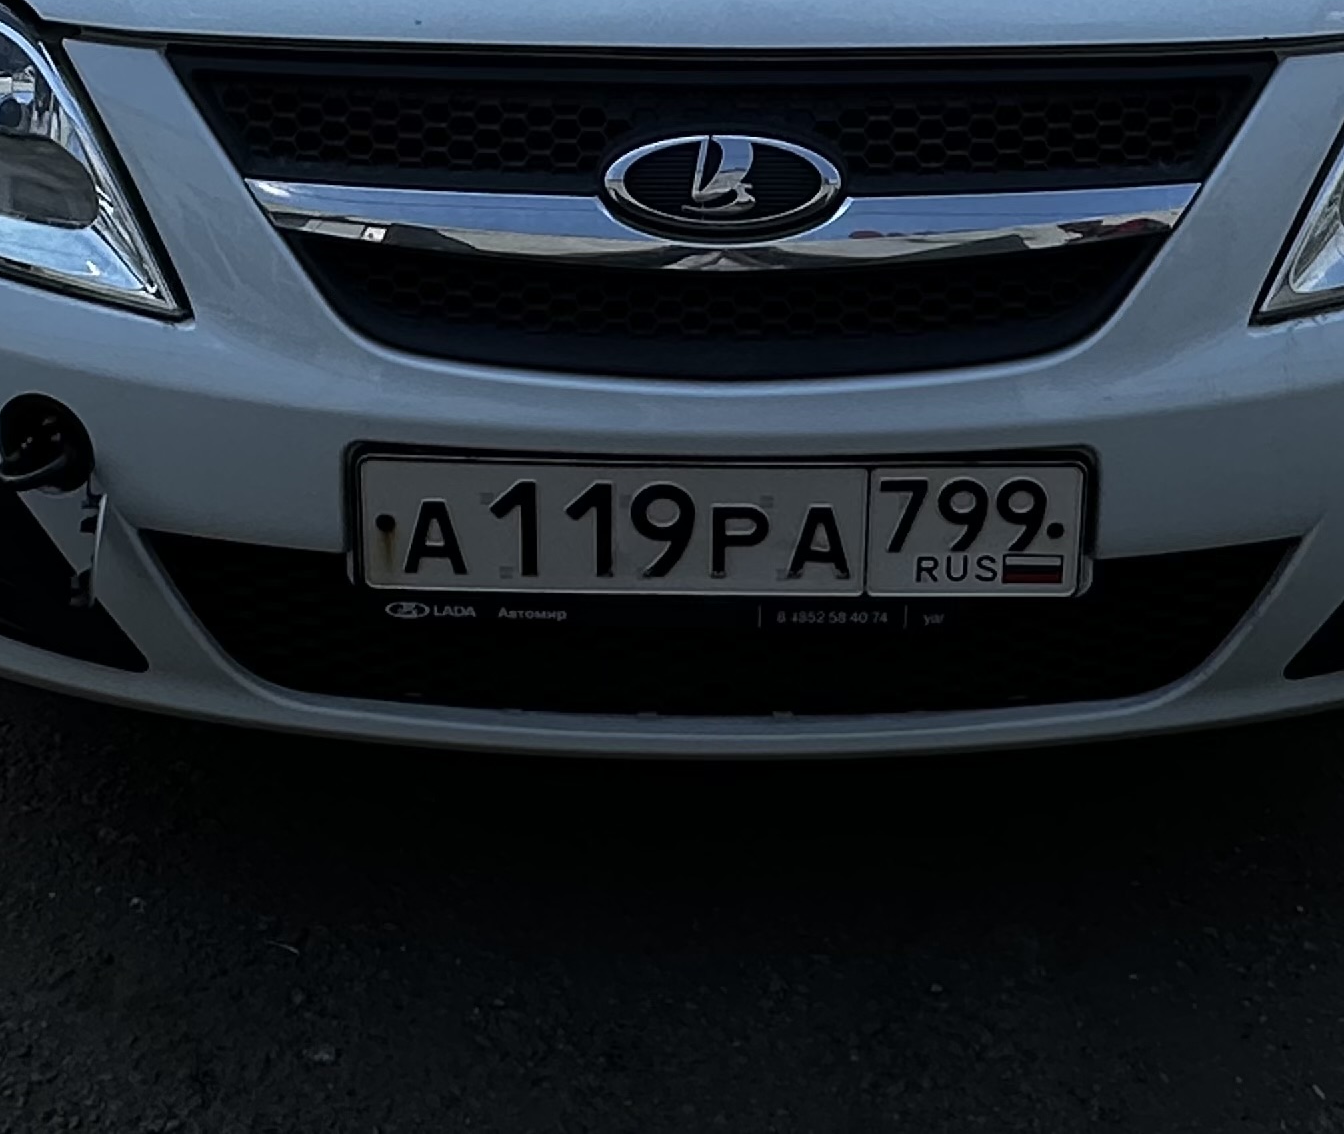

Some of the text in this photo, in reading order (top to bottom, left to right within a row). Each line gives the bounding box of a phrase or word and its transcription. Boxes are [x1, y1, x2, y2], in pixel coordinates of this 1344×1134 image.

[879, 478, 1049, 554] 799
[915, 554, 998, 584] RUS
[433, 604, 477, 618] LADA
[498, 606, 568, 622] Автомир
